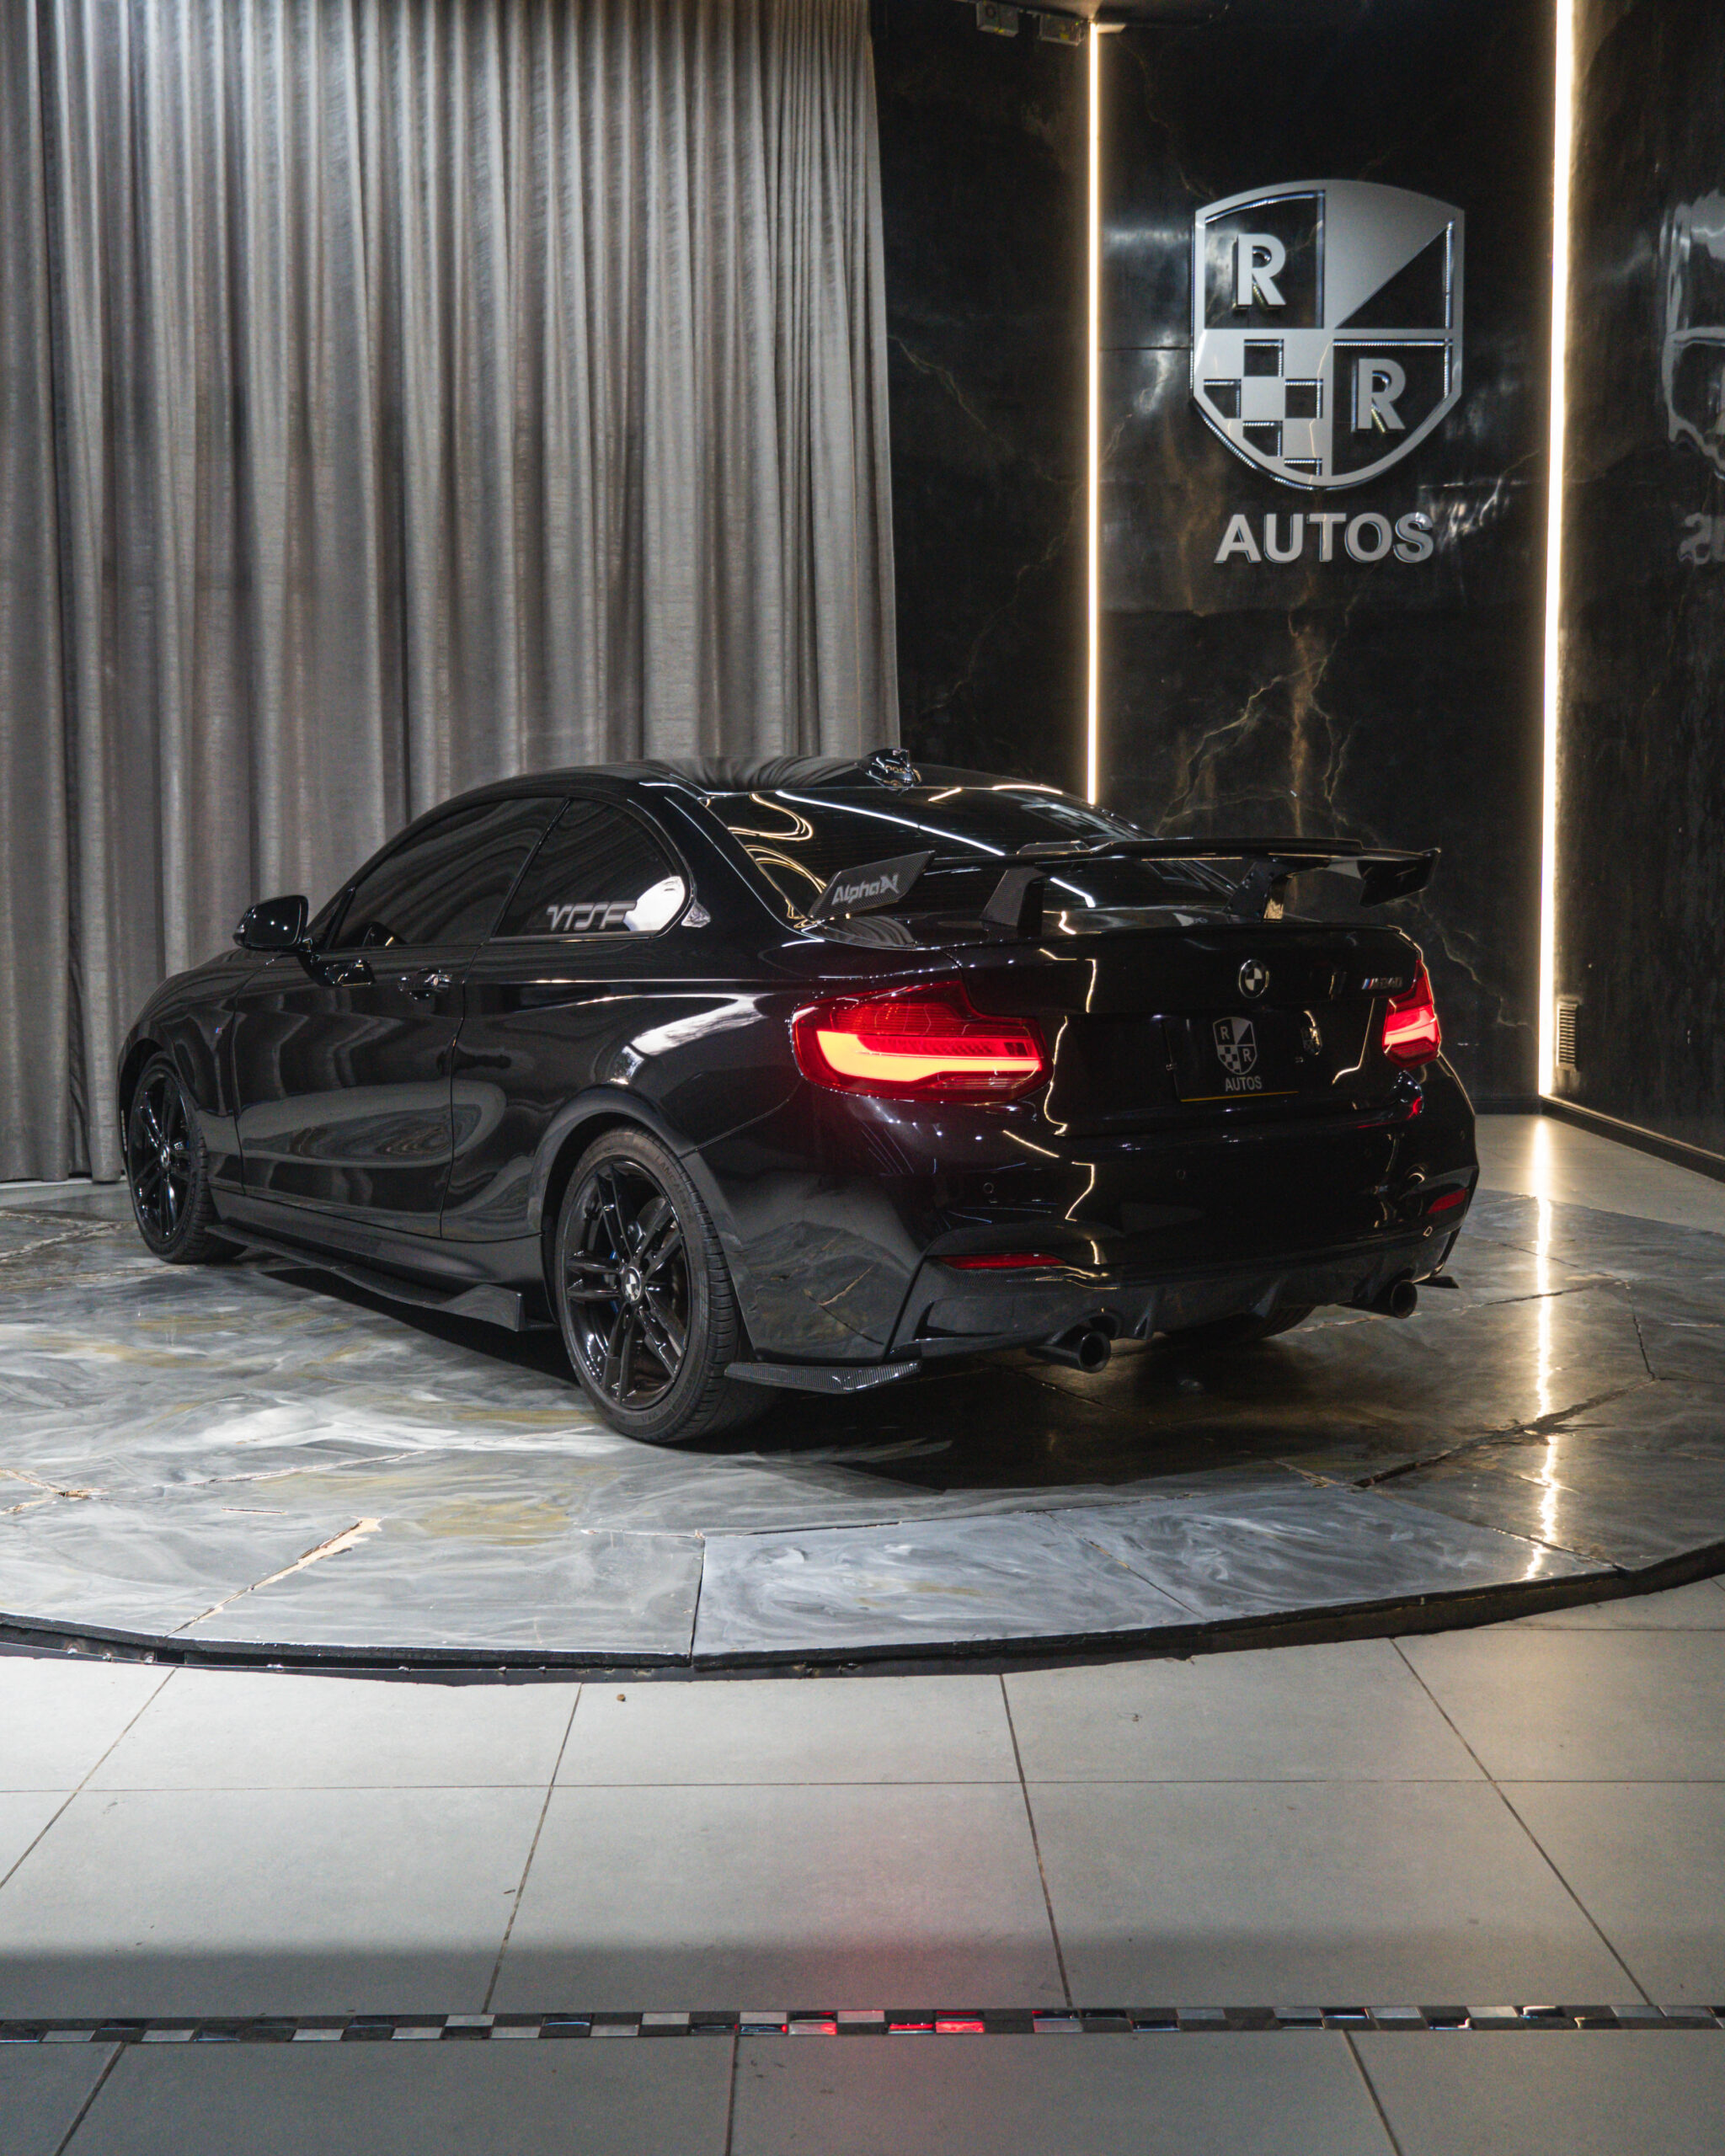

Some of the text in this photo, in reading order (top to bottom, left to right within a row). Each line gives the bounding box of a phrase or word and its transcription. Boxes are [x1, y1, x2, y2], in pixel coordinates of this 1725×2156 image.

[1235, 233, 1287, 307] R
[1354, 358, 1407, 430] R
[1215, 512, 1434, 563] AUTOS
[1220, 1026, 1230, 1040] R
[1242, 1048, 1252, 1062] R
[1225, 1075, 1263, 1092] AUTOS
